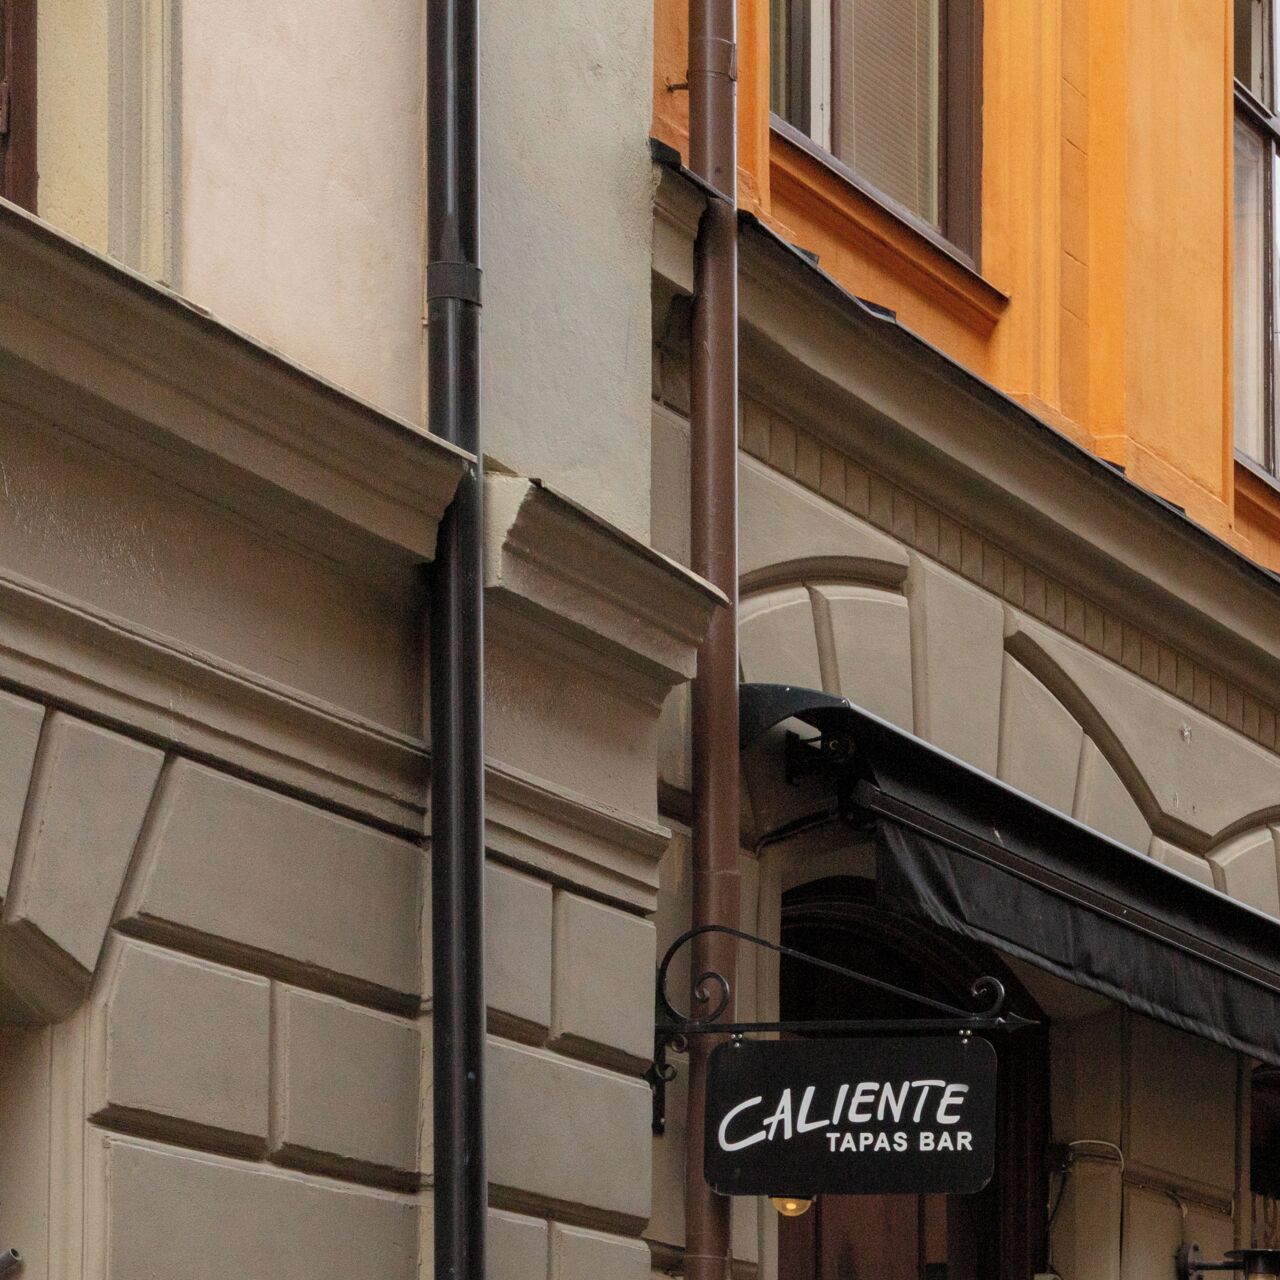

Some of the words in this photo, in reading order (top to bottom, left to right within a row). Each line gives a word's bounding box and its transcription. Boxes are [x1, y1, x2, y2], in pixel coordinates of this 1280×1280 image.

[718, 1079, 969, 1151] CALIENTE
[826, 1131, 908, 1152] TAPAS
[919, 1131, 972, 1151] BAR
